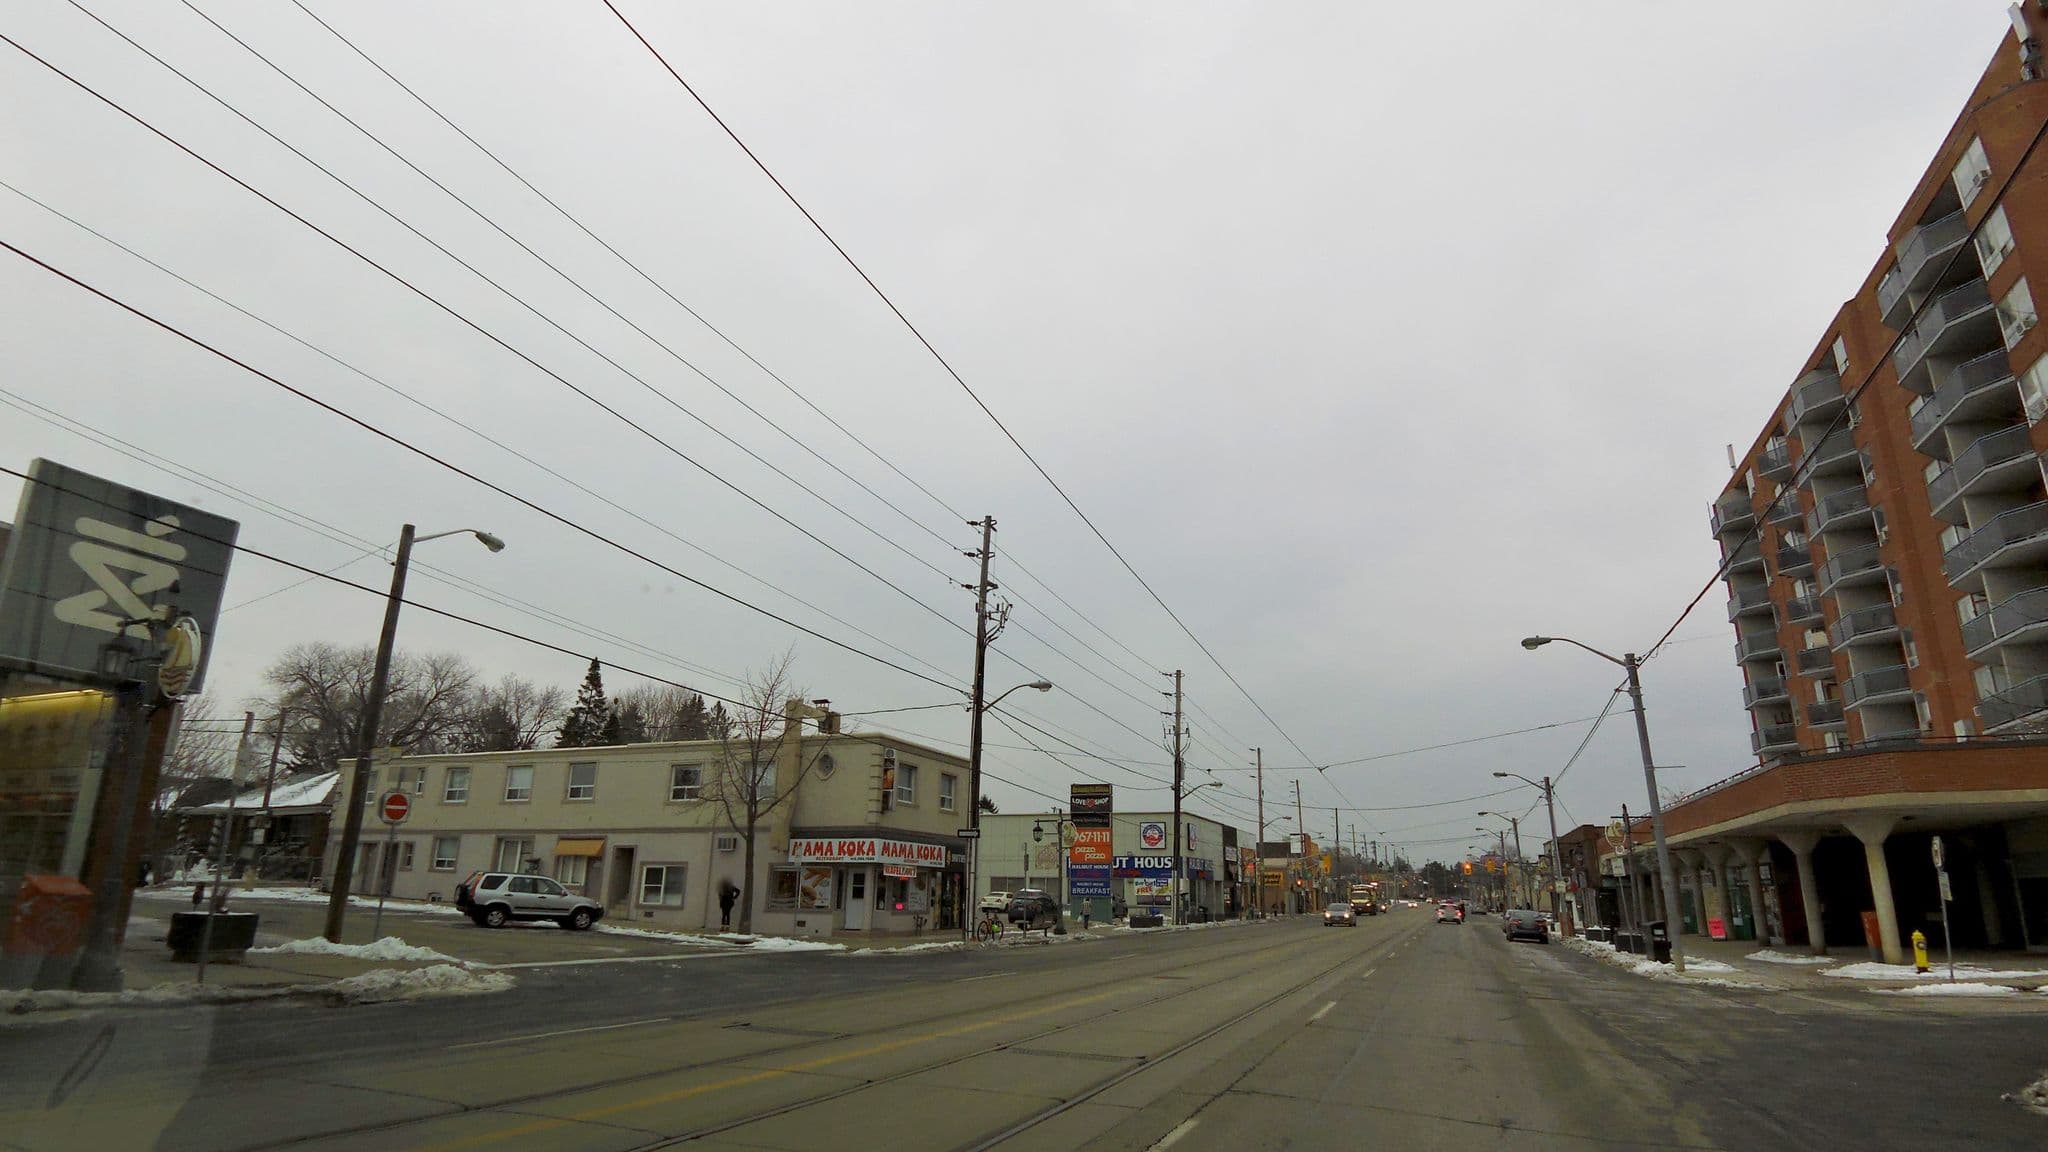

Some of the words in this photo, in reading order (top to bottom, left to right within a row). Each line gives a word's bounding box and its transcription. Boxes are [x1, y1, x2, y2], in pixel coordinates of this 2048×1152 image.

[1072, 797, 1086, 806] LOVE
[1094, 797, 1109, 805] SHOP
[838, 840, 876, 857] KOKA
[881, 841, 914, 859] MAMA
[917, 846, 943, 861] KOKA
[1134, 856, 1174, 868] HOUS
[1136, 886, 1153, 895] FREE
